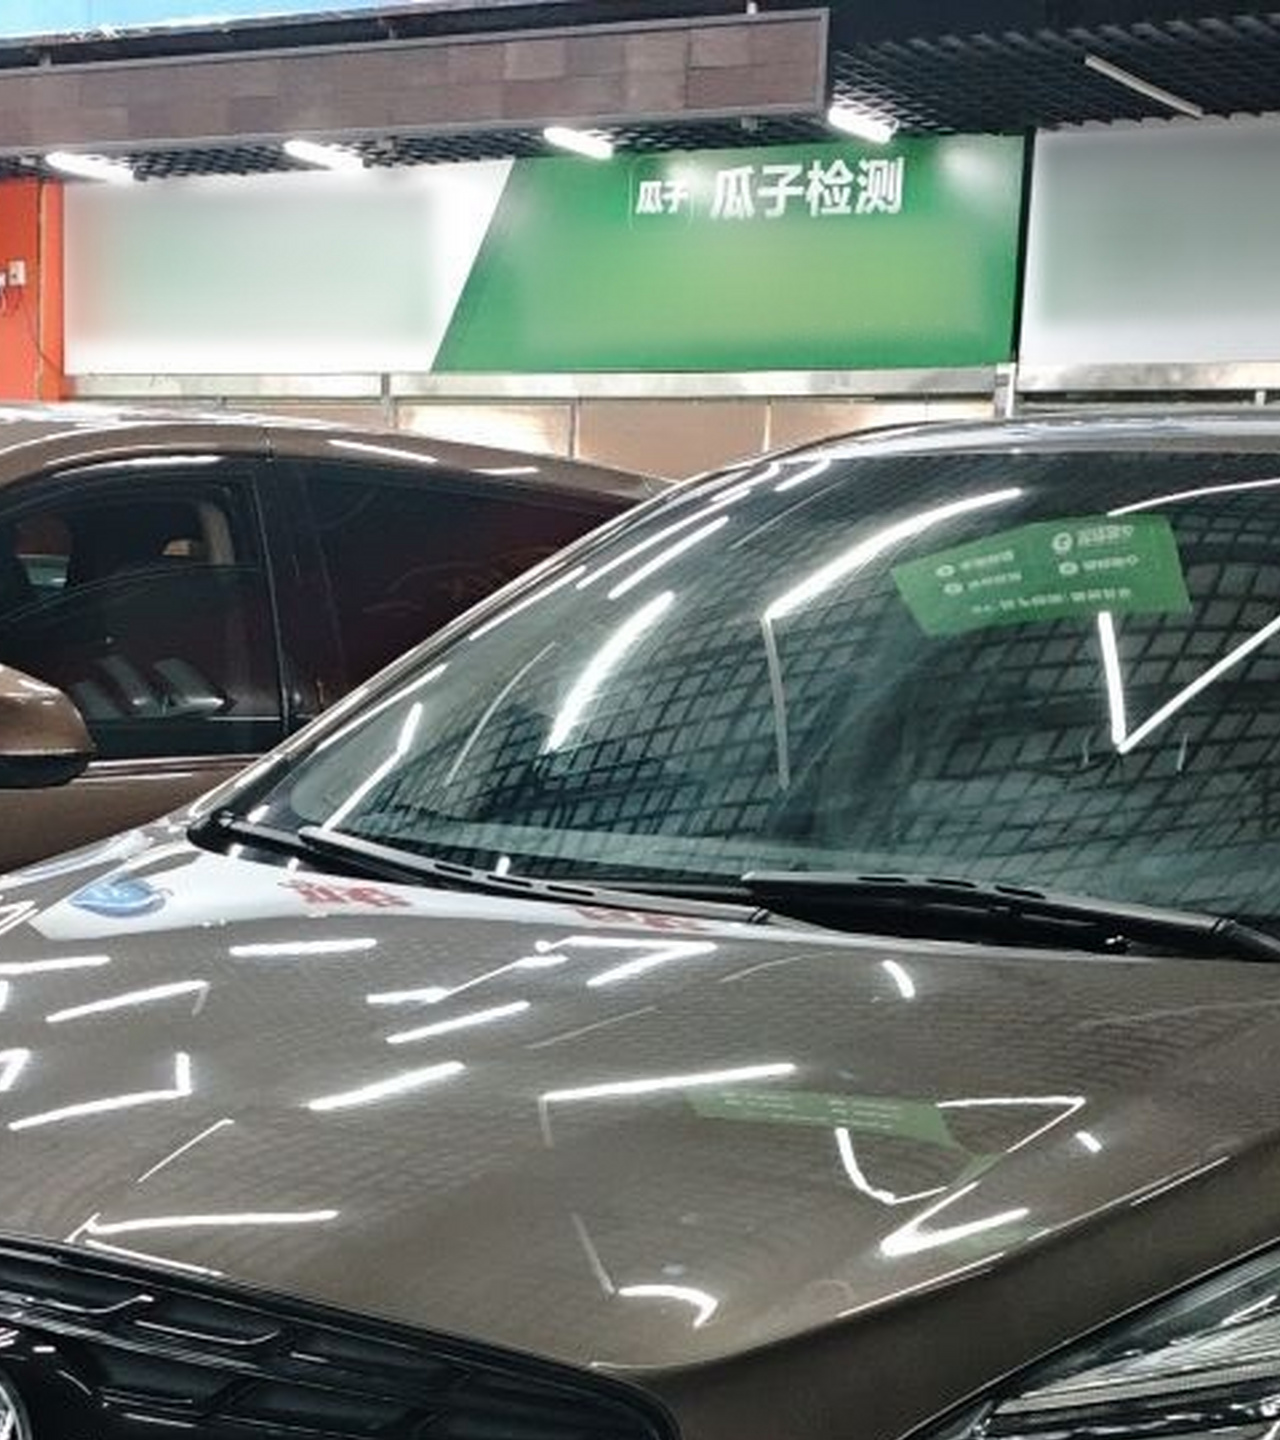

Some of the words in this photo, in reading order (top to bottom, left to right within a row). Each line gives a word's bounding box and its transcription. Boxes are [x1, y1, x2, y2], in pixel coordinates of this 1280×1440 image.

[635, 179, 689, 214] 瓜子
[709, 156, 895, 220] 瓜子检测
